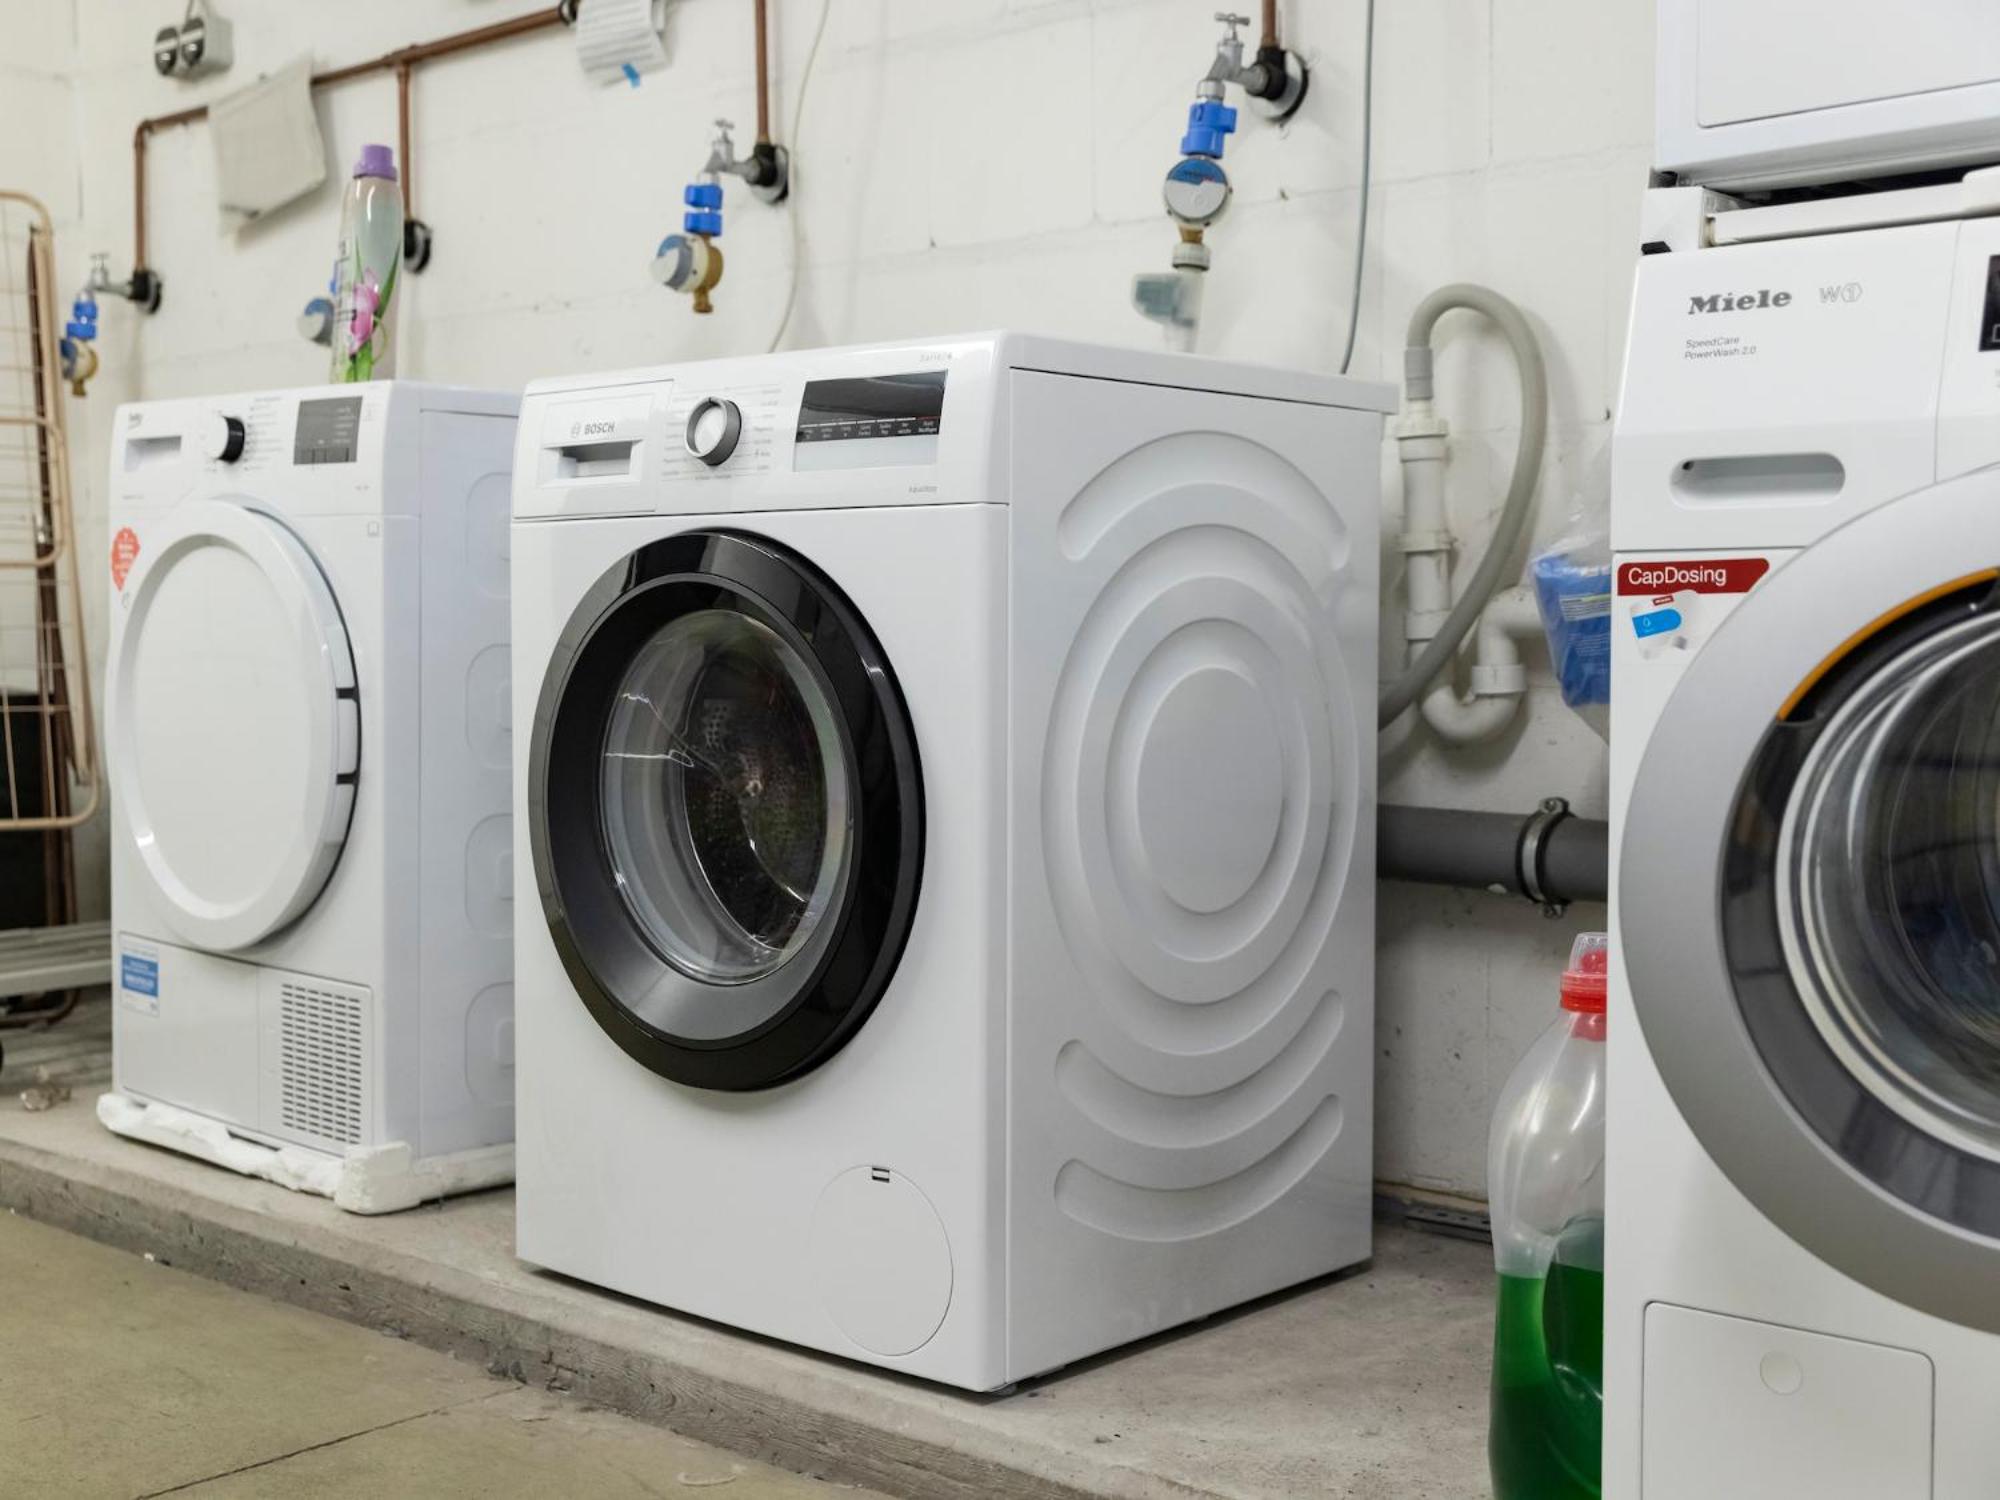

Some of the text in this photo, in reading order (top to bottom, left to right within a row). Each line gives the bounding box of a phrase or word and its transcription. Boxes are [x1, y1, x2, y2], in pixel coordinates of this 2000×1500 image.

[1688, 290, 1792, 315] Miele
[1686, 337, 1740, 349] SpeedCare
[1685, 345, 1757, 359] PowerWash 2.0
[585, 421, 615, 435] BOSCH
[1628, 566, 1727, 588] CapDosing
